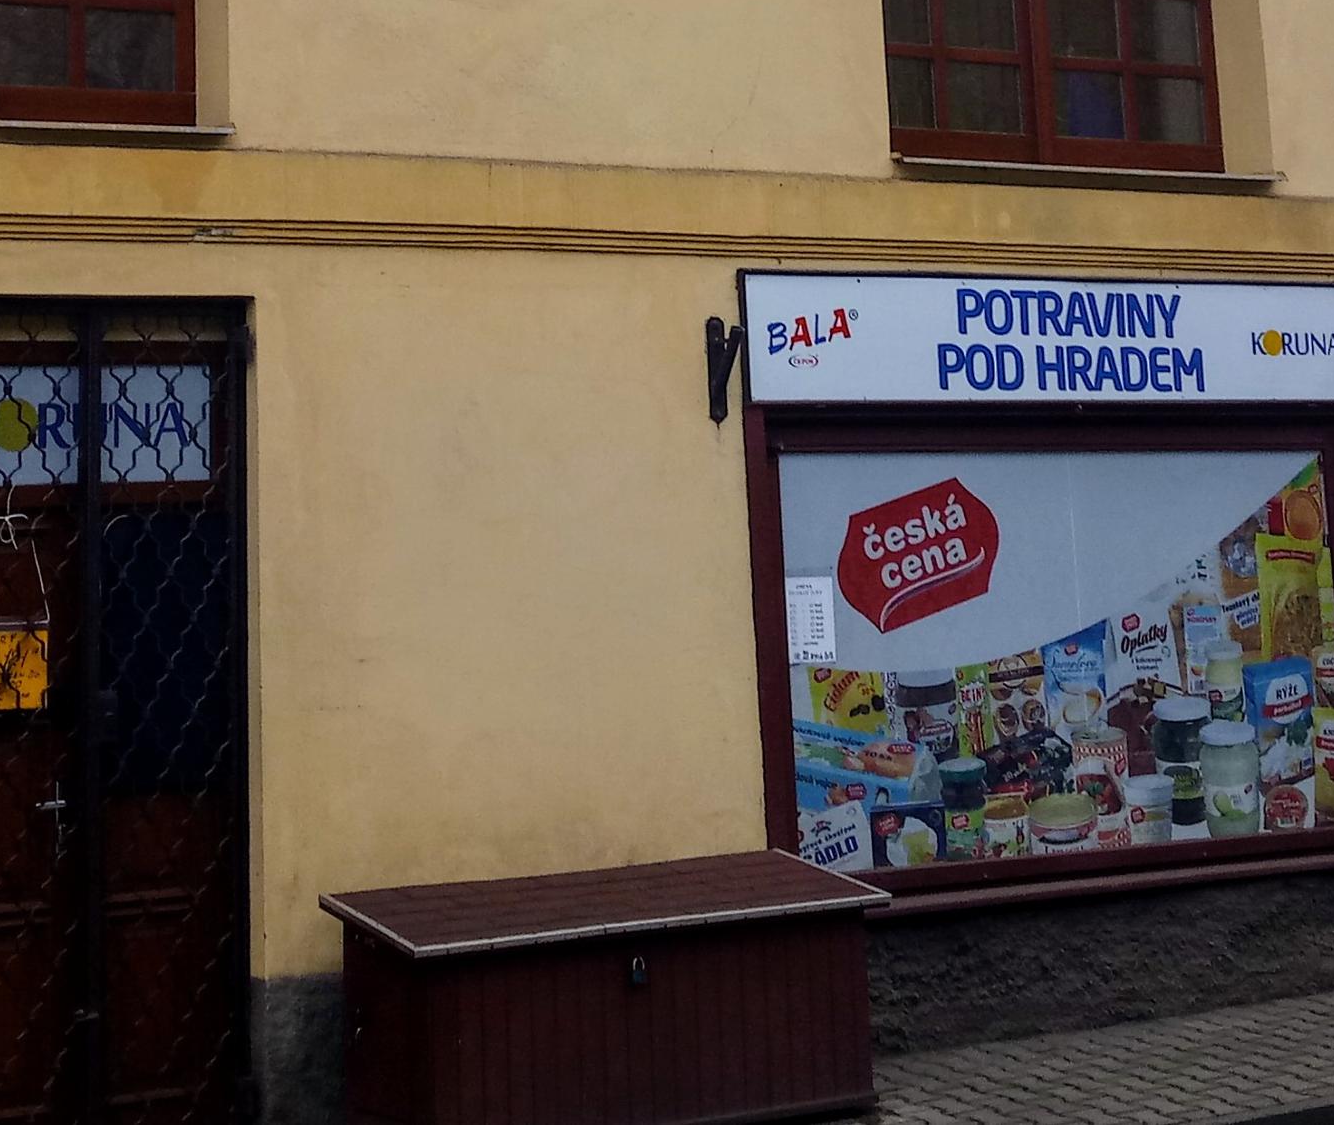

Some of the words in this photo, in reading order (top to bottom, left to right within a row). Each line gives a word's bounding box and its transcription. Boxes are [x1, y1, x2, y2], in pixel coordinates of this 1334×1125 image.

[767, 308, 852, 356] BALA
[956, 288, 1181, 340] POTRAVINY
[937, 343, 1027, 391] POD
[1037, 345, 1206, 393] HRADEM
[862, 493, 968, 562] česká
[880, 536, 968, 590] cena
[1120, 623, 1168, 658] Oplatky
[1276, 683, 1299, 700] RÝŽE
[803, 836, 864, 866] ÁDLO
